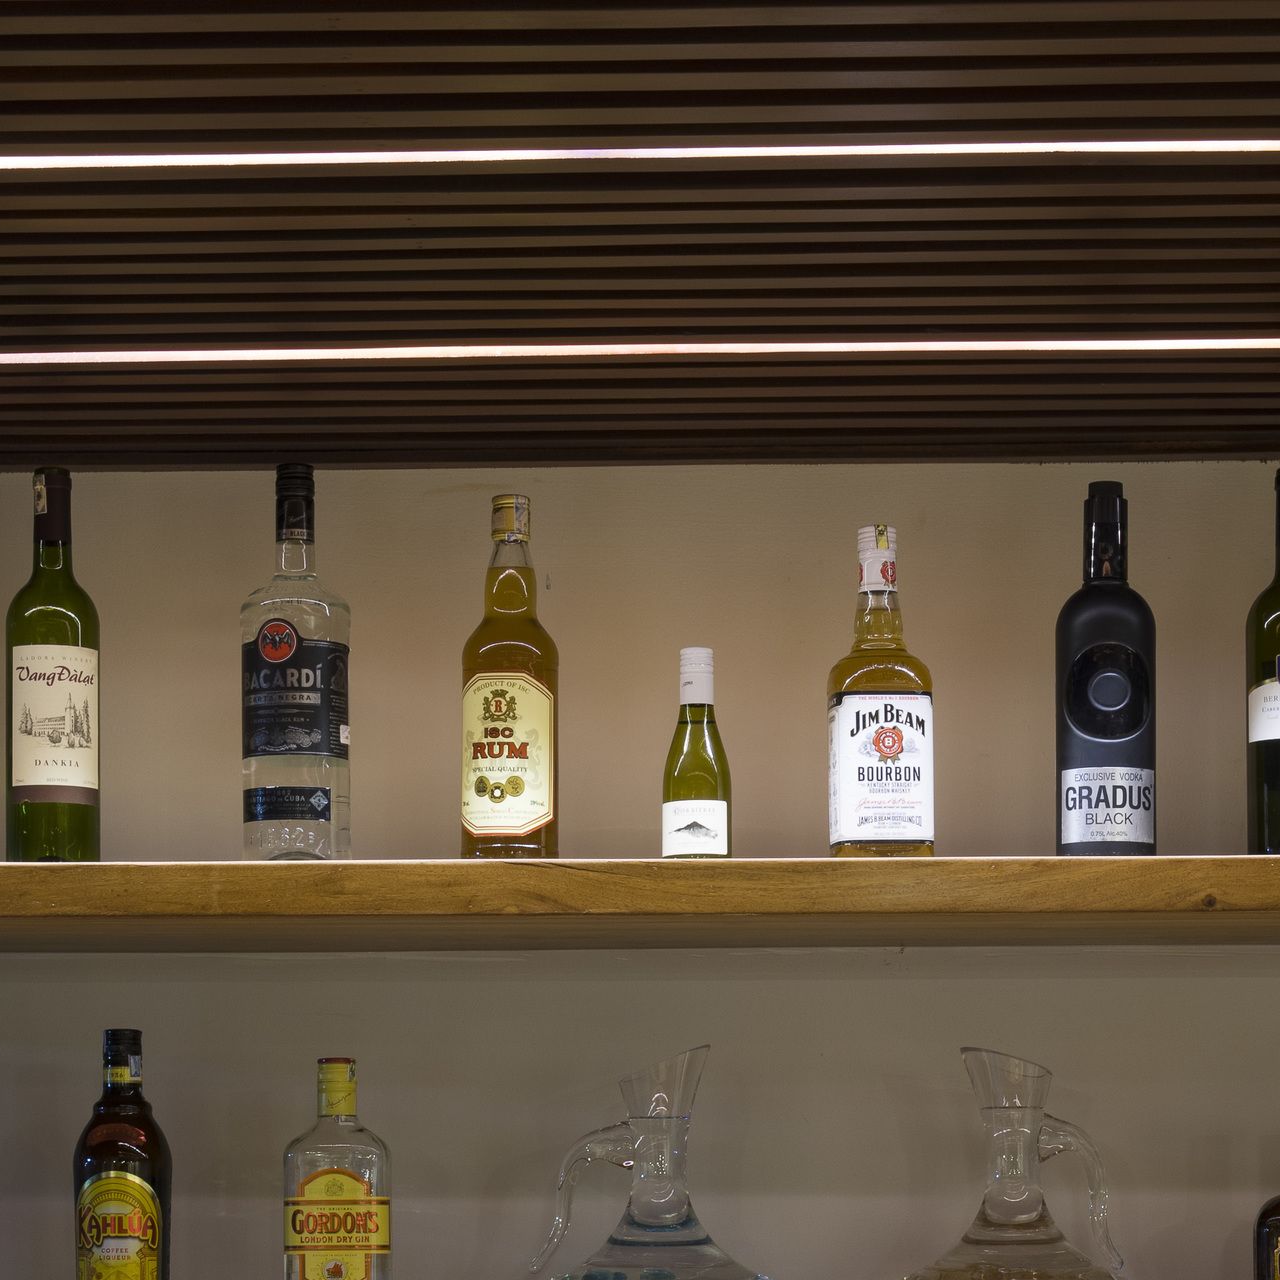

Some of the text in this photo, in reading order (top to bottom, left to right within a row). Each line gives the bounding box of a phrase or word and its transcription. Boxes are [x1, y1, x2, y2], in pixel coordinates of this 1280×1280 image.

[473, 680, 505, 695] PRODUCT
[850, 703, 926, 738] JIM BEAM
[483, 727, 515, 739] ISC
[471, 741, 529, 760] RUM
[34, 759, 80, 768] DANKIA
[472, 766, 497, 774] SPECIAL
[857, 766, 921, 782] BOURBON
[1074, 772, 1144, 783] EXCLUSIVE VODKA
[1065, 785, 1150, 812] GRADUS
[1085, 812, 1134, 825] BLACK
[78, 1203, 159, 1249] KAHLÚA
[291, 1209, 380, 1235] GORDON'S
[300, 1236, 370, 1244] LONDON DRY GIN
